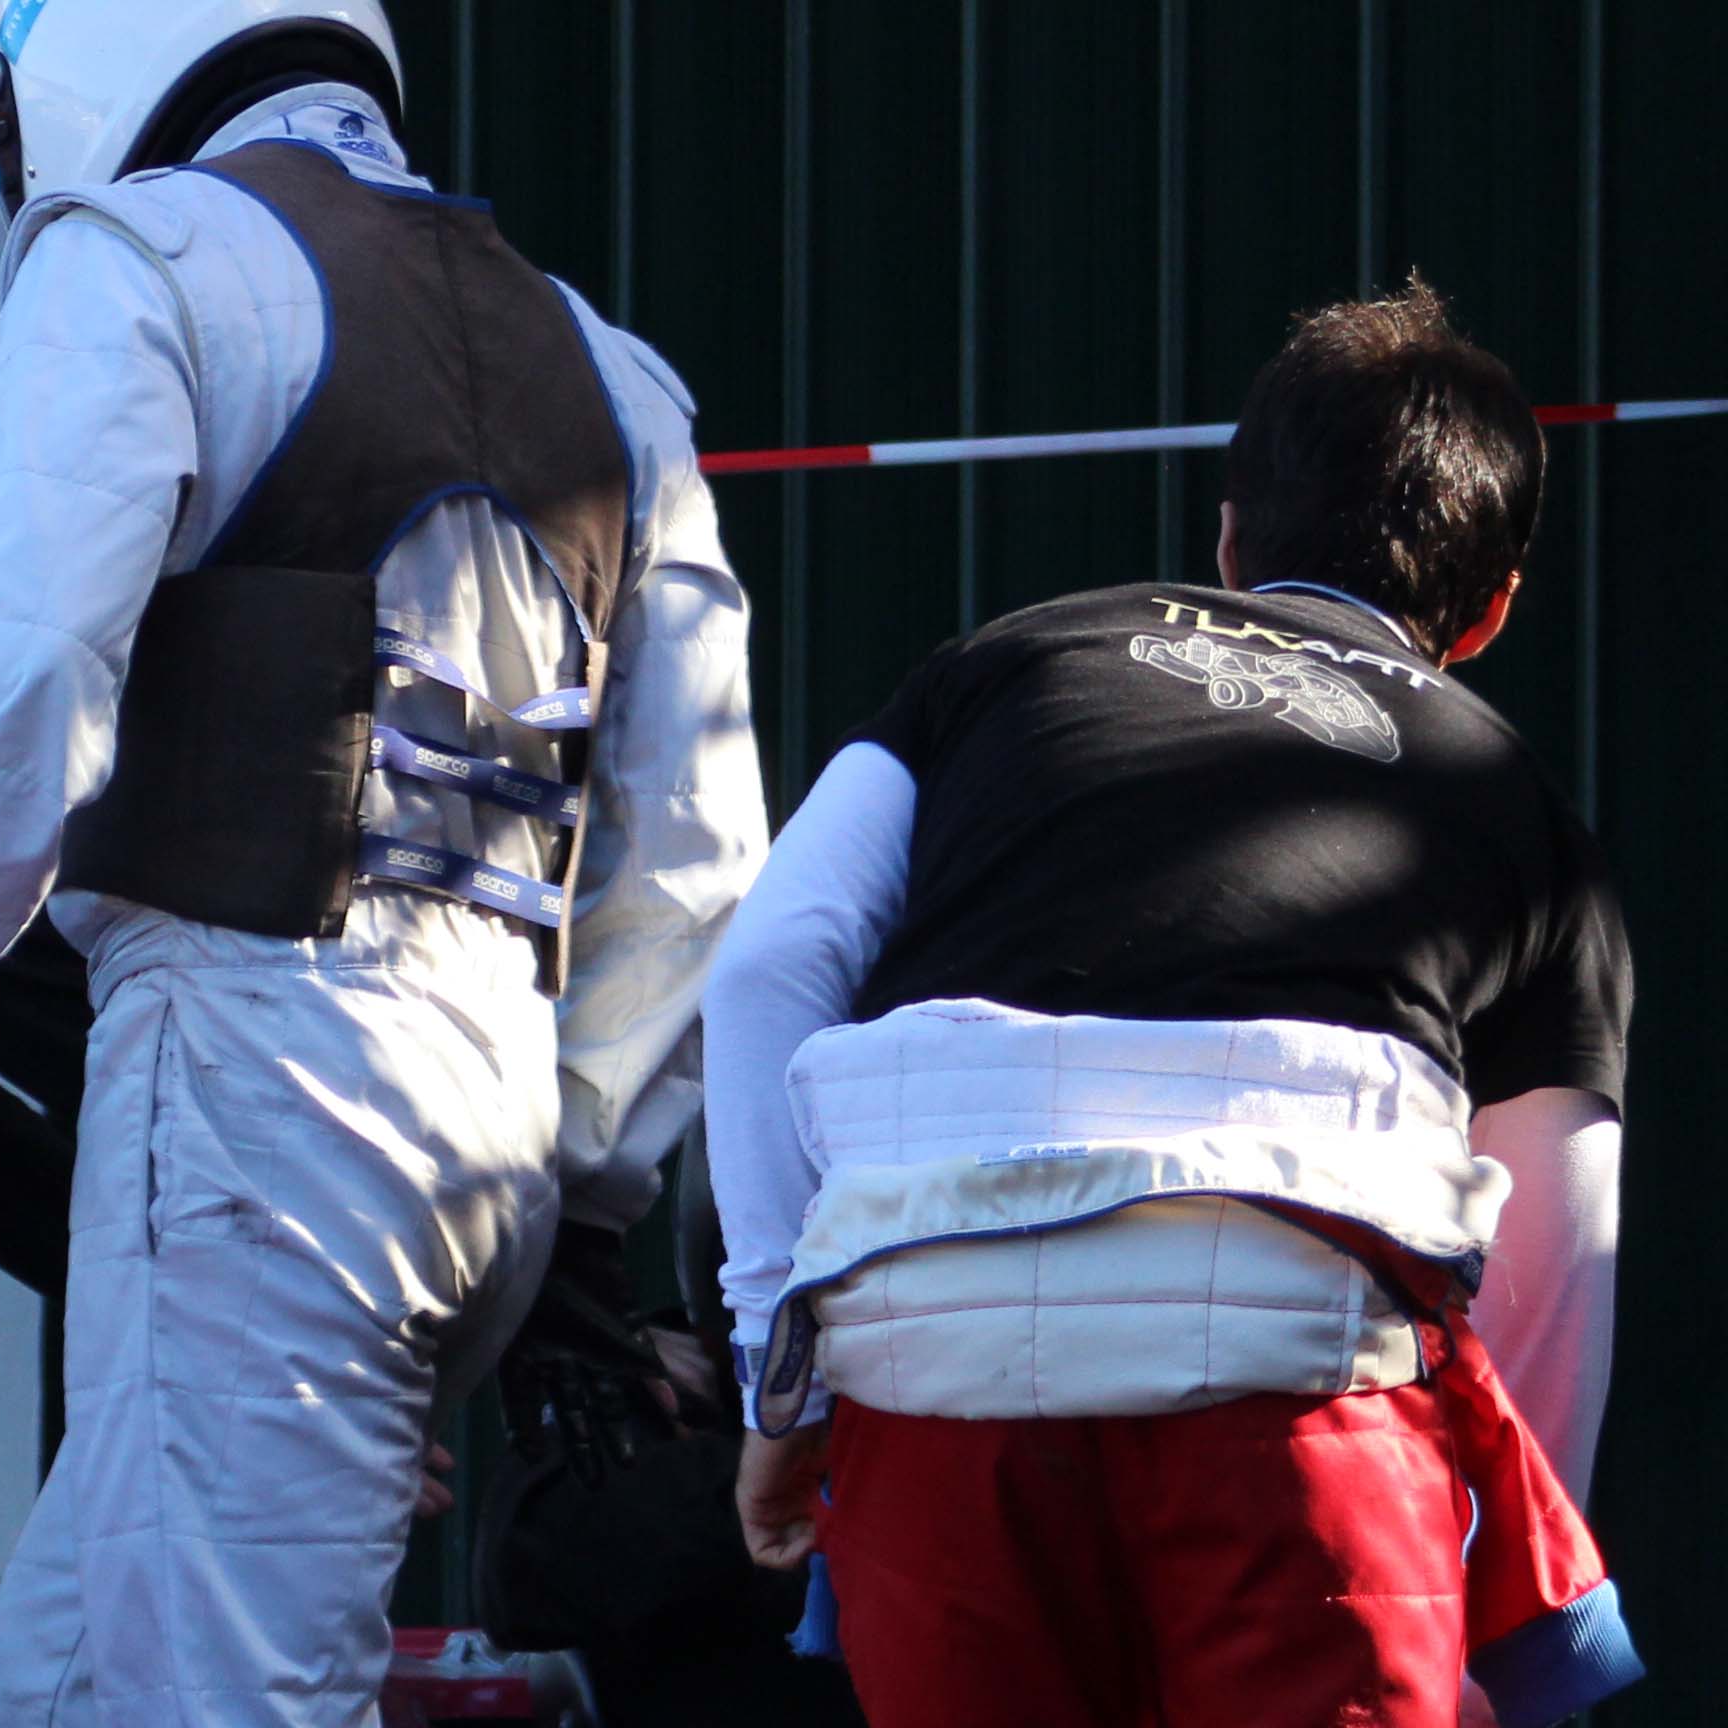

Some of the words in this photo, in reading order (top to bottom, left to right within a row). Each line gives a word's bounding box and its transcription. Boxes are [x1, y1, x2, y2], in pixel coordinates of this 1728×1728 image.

[414, 747, 471, 777] sparco
[386, 848, 445, 871] sparco
[472, 871, 519, 899] sparco
